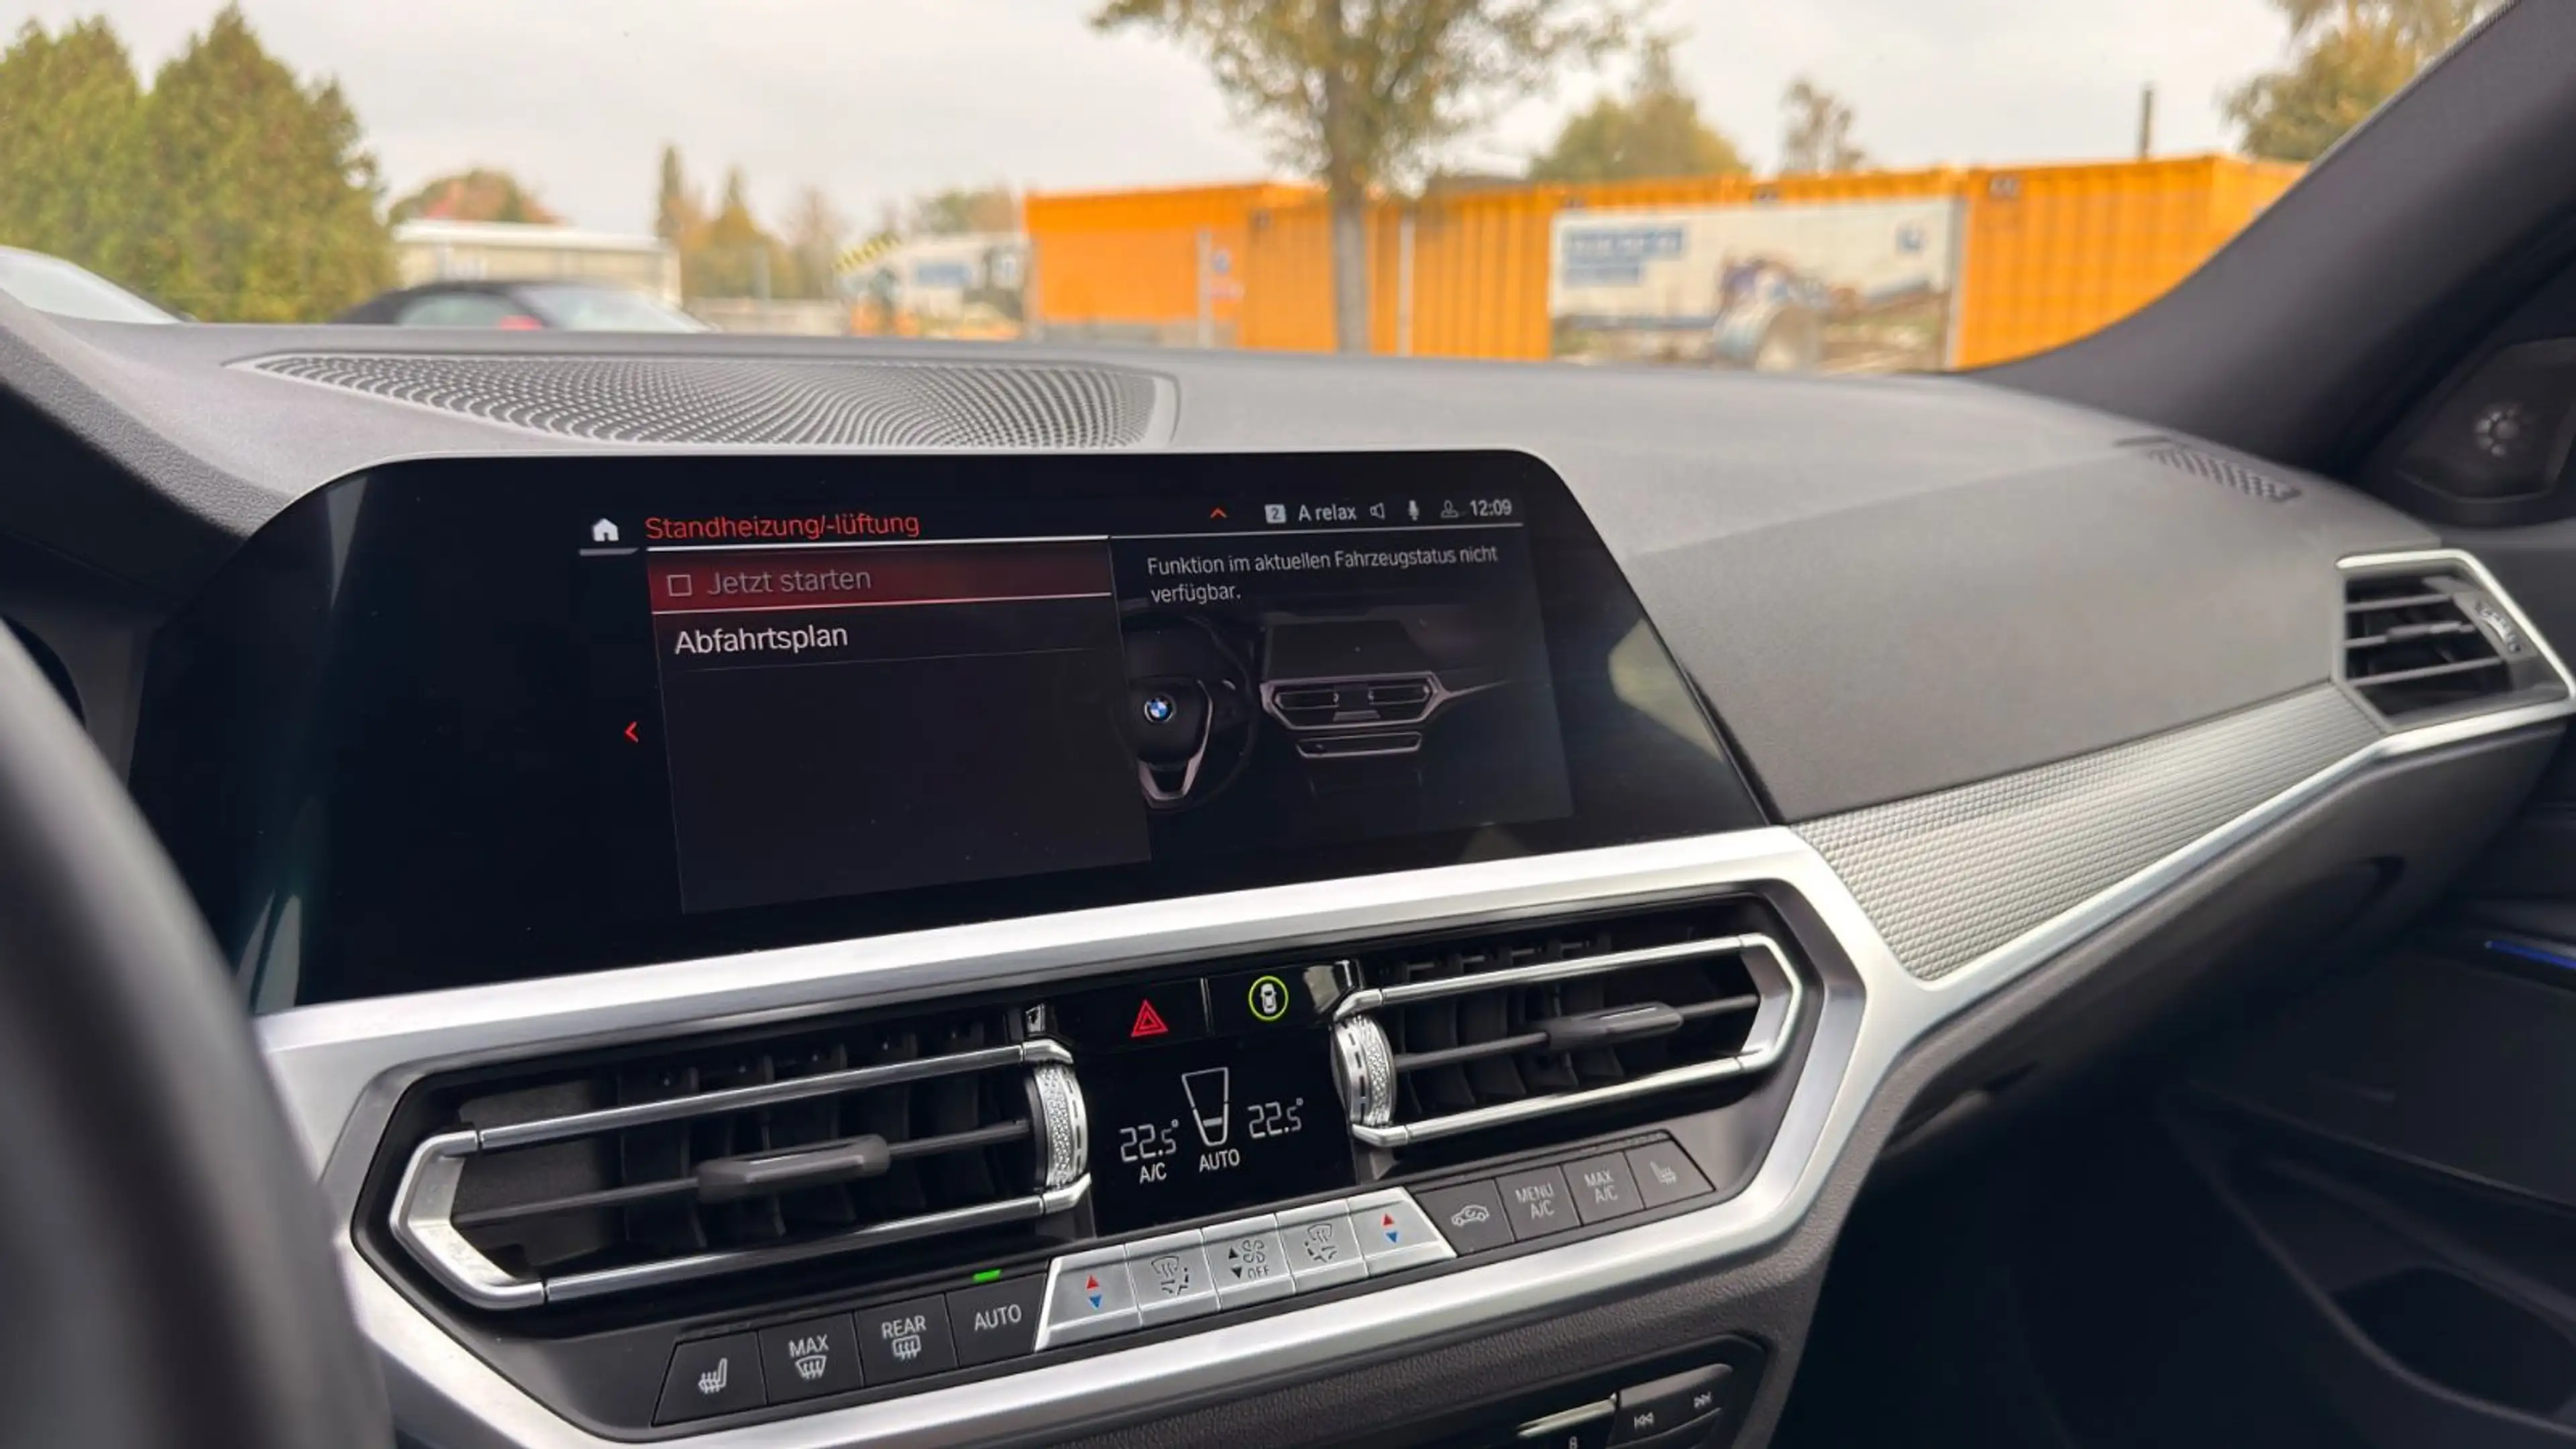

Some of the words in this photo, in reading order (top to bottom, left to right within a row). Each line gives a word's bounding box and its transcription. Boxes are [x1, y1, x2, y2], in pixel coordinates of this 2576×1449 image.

[1297, 505, 1312, 521] A
[1316, 504, 1356, 521] relax
[1470, 500, 1512, 517] 12:09
[645, 514, 920, 539] Standheizung/-lüftung
[1148, 555, 1224, 575] Funktion
[1230, 555, 1251, 573] im
[1254, 551, 1331, 572] aktuellen
[1334, 547, 1456, 568] Fahrzeugstatus
[1460, 545, 1498, 563] nicht
[707, 572, 773, 596] Jetzt
[780, 568, 872, 592] starten
[1151, 583, 1241, 604] verfügbar.
[675, 625, 849, 655] Abfahrtsplan
[1199, 1148, 1240, 1171] AUTO
[1139, 1163, 1167, 1184] A/C
[1584, 1169, 1613, 1187] MAX
[1515, 1183, 1555, 1203] MENU
[1595, 1185, 1618, 1203] A/C
[1530, 1200, 1555, 1219] A/C
[881, 1316, 926, 1338] REAR
[974, 1304, 1022, 1330] AUTO
[788, 1334, 830, 1358] MAX
